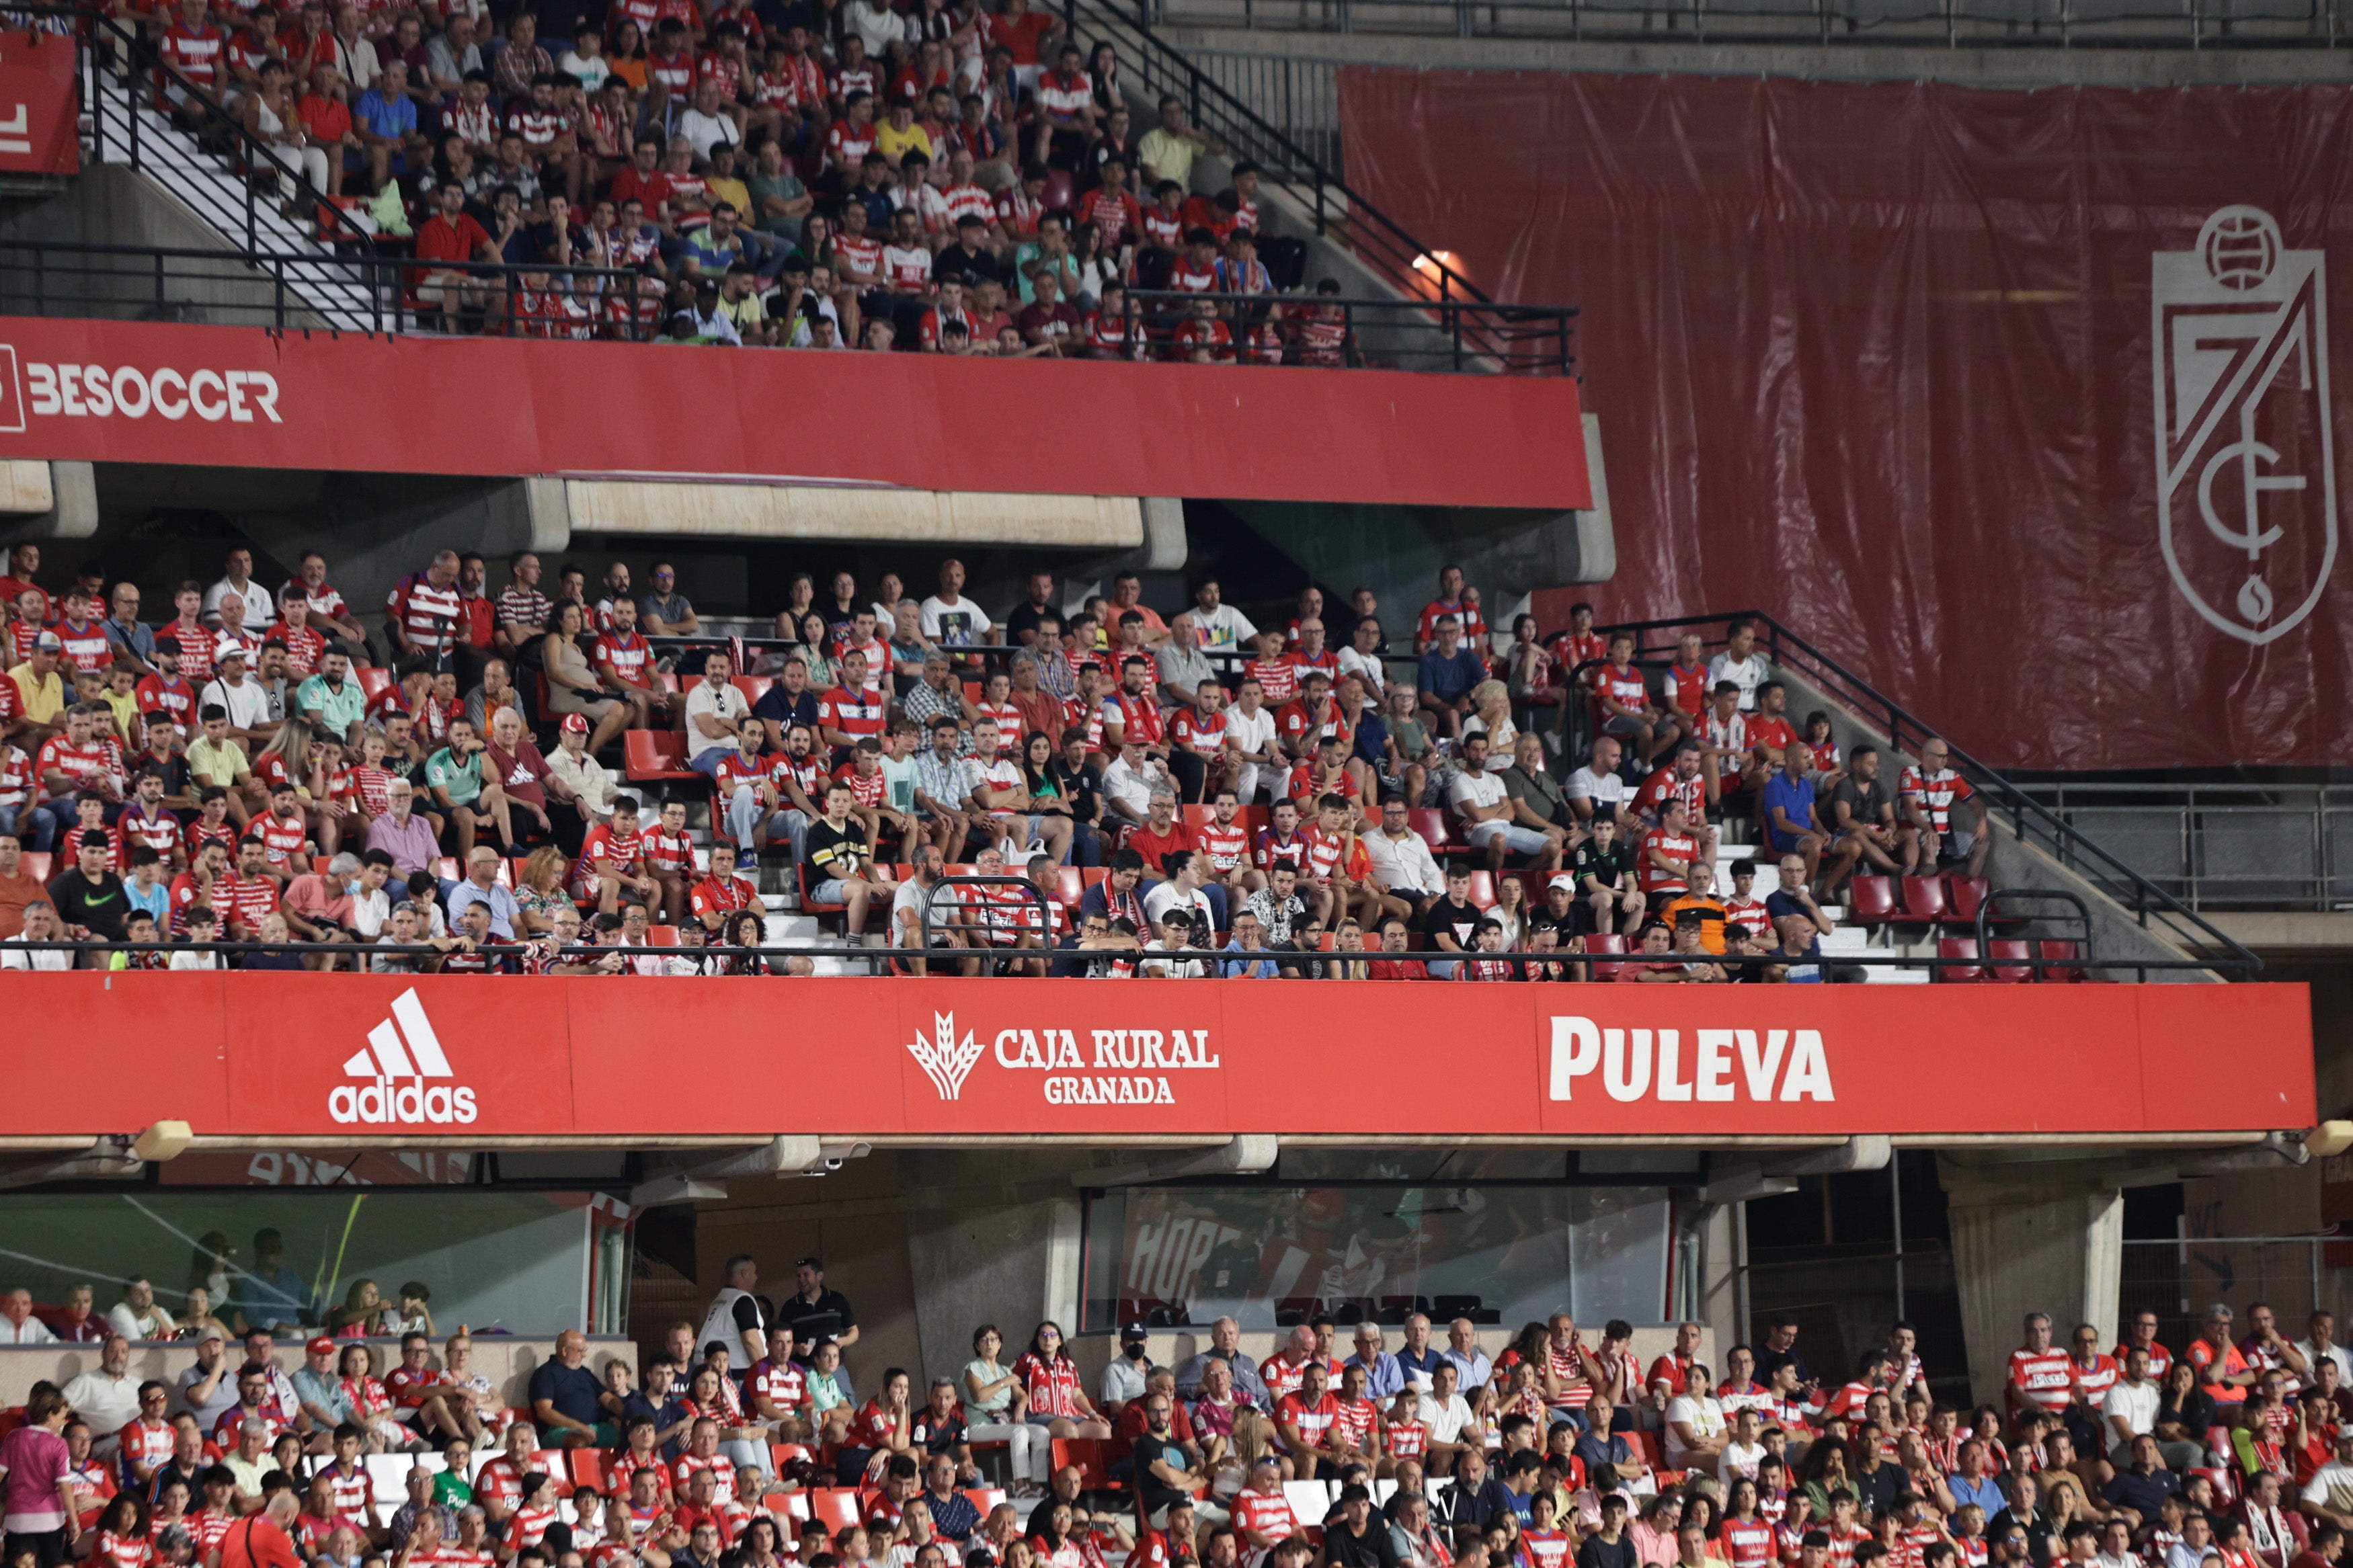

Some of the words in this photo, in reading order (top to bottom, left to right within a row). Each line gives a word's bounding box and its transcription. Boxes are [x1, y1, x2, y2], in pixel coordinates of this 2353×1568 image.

[26, 363, 283, 423] BESOCCER
[995, 1030, 1085, 1071] CAJA
[1091, 1030, 1220, 1069] RURAL
[1550, 1016, 1835, 1102] PULEVA
[329, 1075, 477, 1124] adidas
[1044, 1077, 1175, 1104] GRANADA
